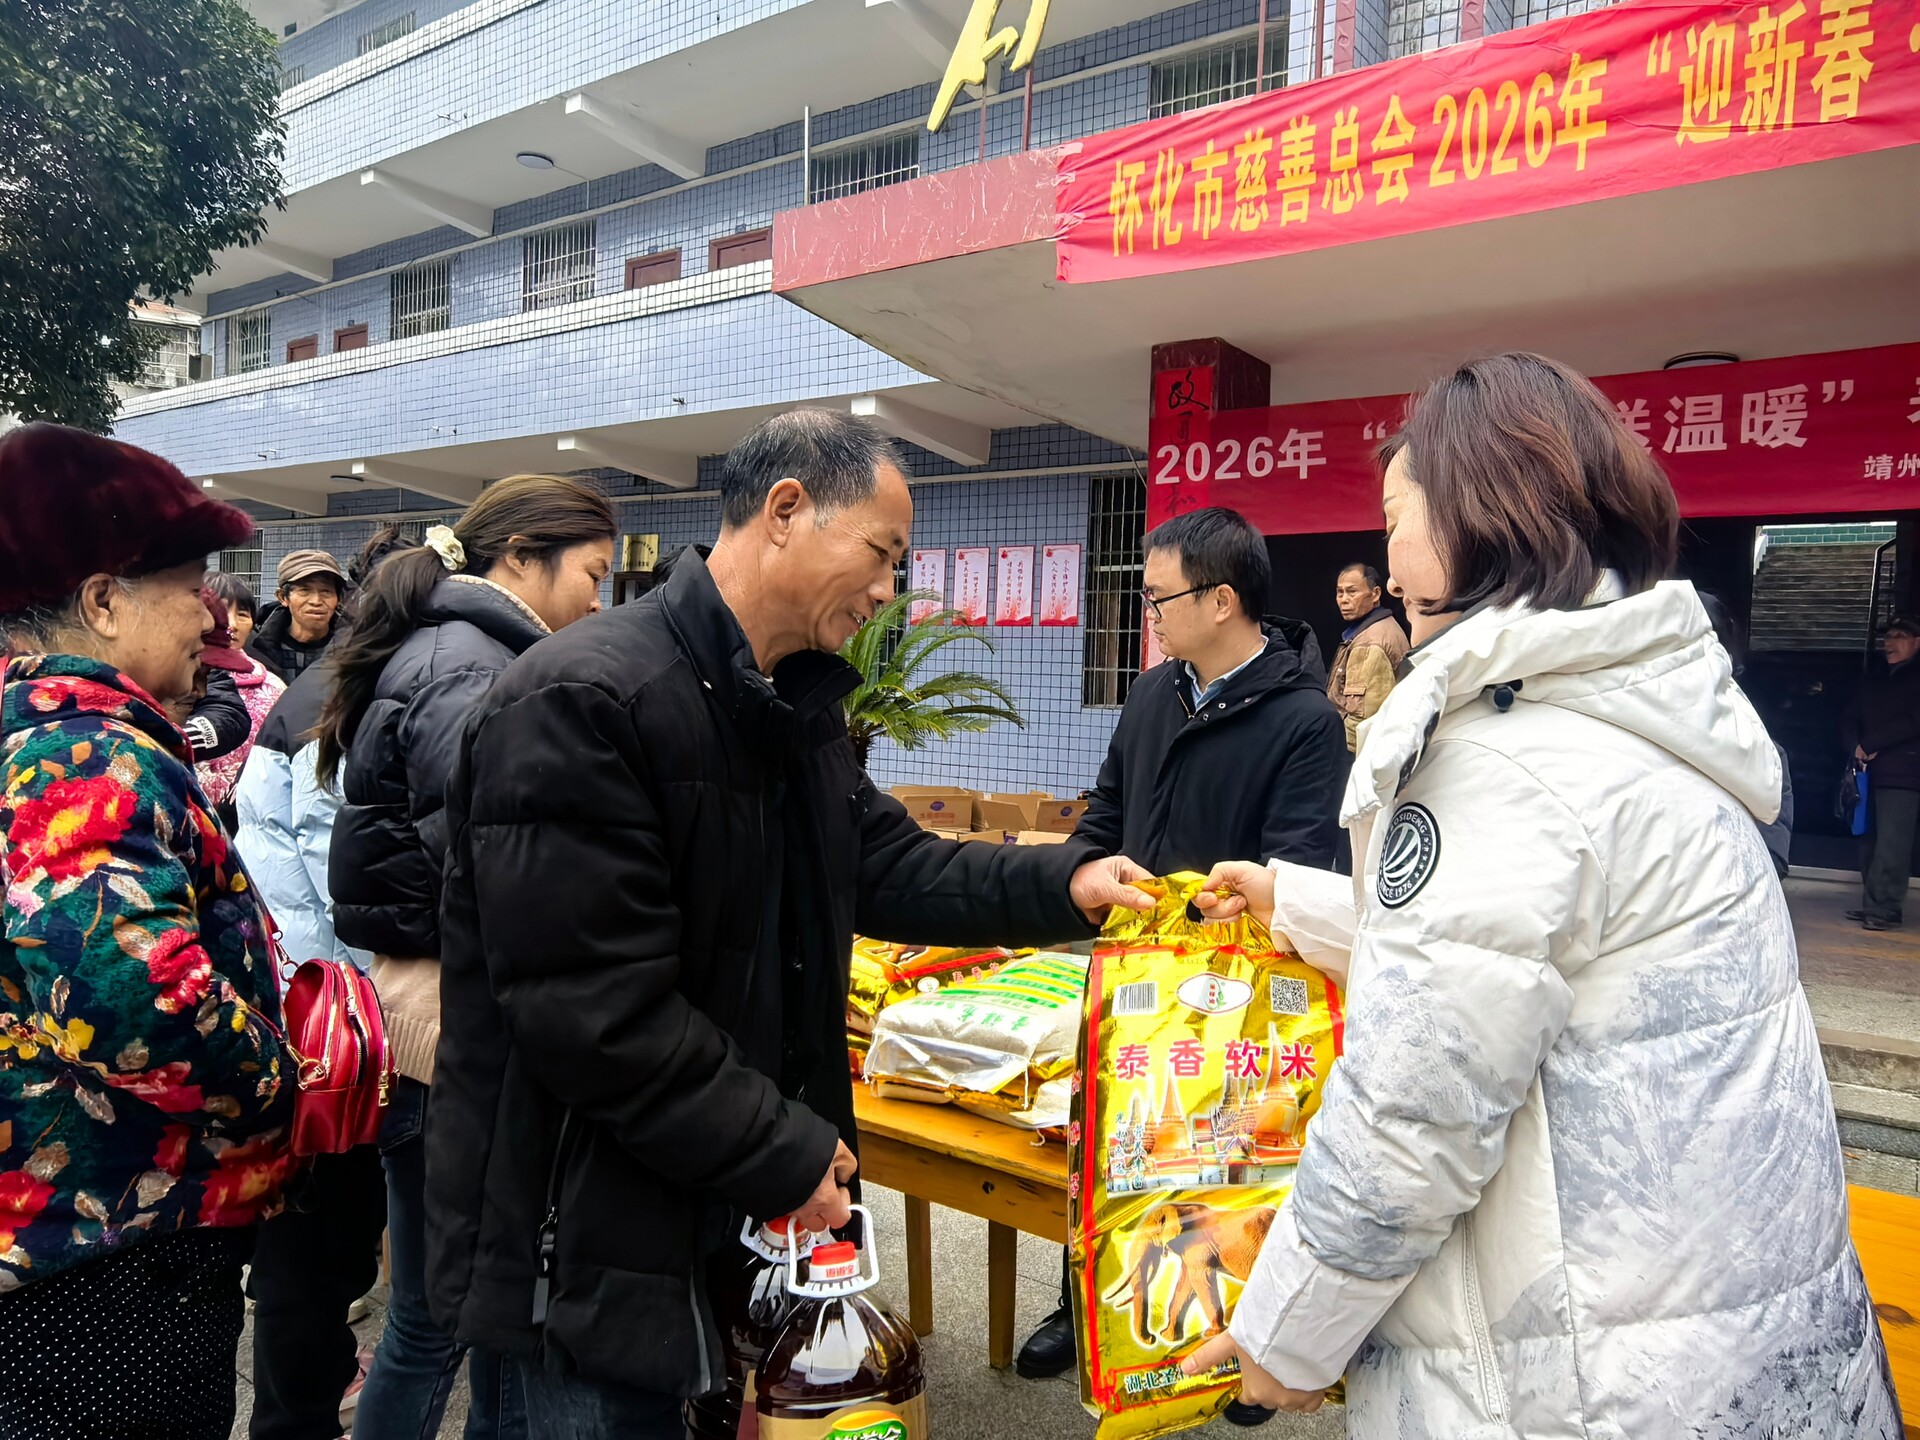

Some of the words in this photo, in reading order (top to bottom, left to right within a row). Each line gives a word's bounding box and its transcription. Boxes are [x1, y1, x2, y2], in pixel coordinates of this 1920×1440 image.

[1109, 52, 1607, 257] 怀化市慈善总会2026年
[1155, 428, 1327, 485] 2026年
[1395, 881, 1412, 898] 1976
[1116, 1038, 1318, 1081] 泰香软米
